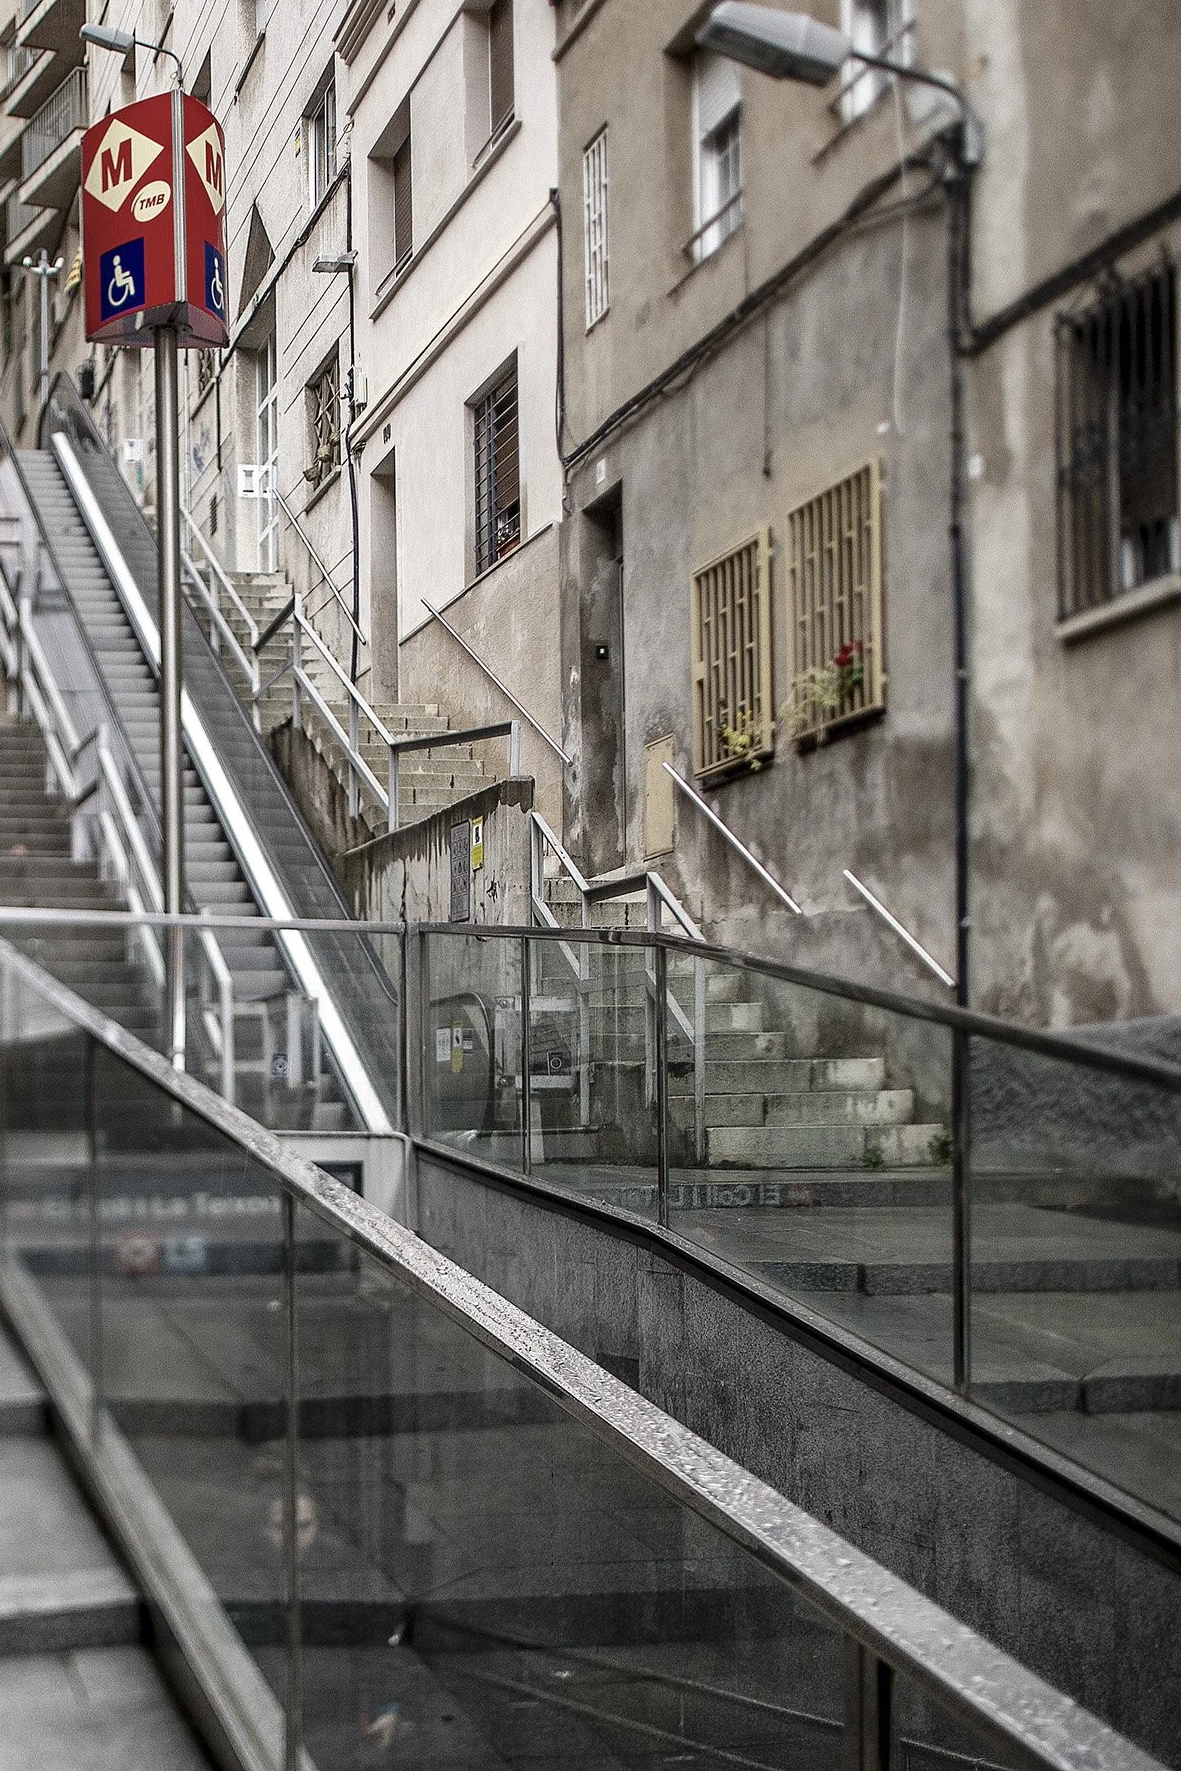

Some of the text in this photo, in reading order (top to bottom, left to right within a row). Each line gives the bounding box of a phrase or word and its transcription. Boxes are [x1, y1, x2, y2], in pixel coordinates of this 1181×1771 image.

[102, 138, 132, 193] M
[205, 139, 223, 198] M
[139, 193, 165, 211] TMB
